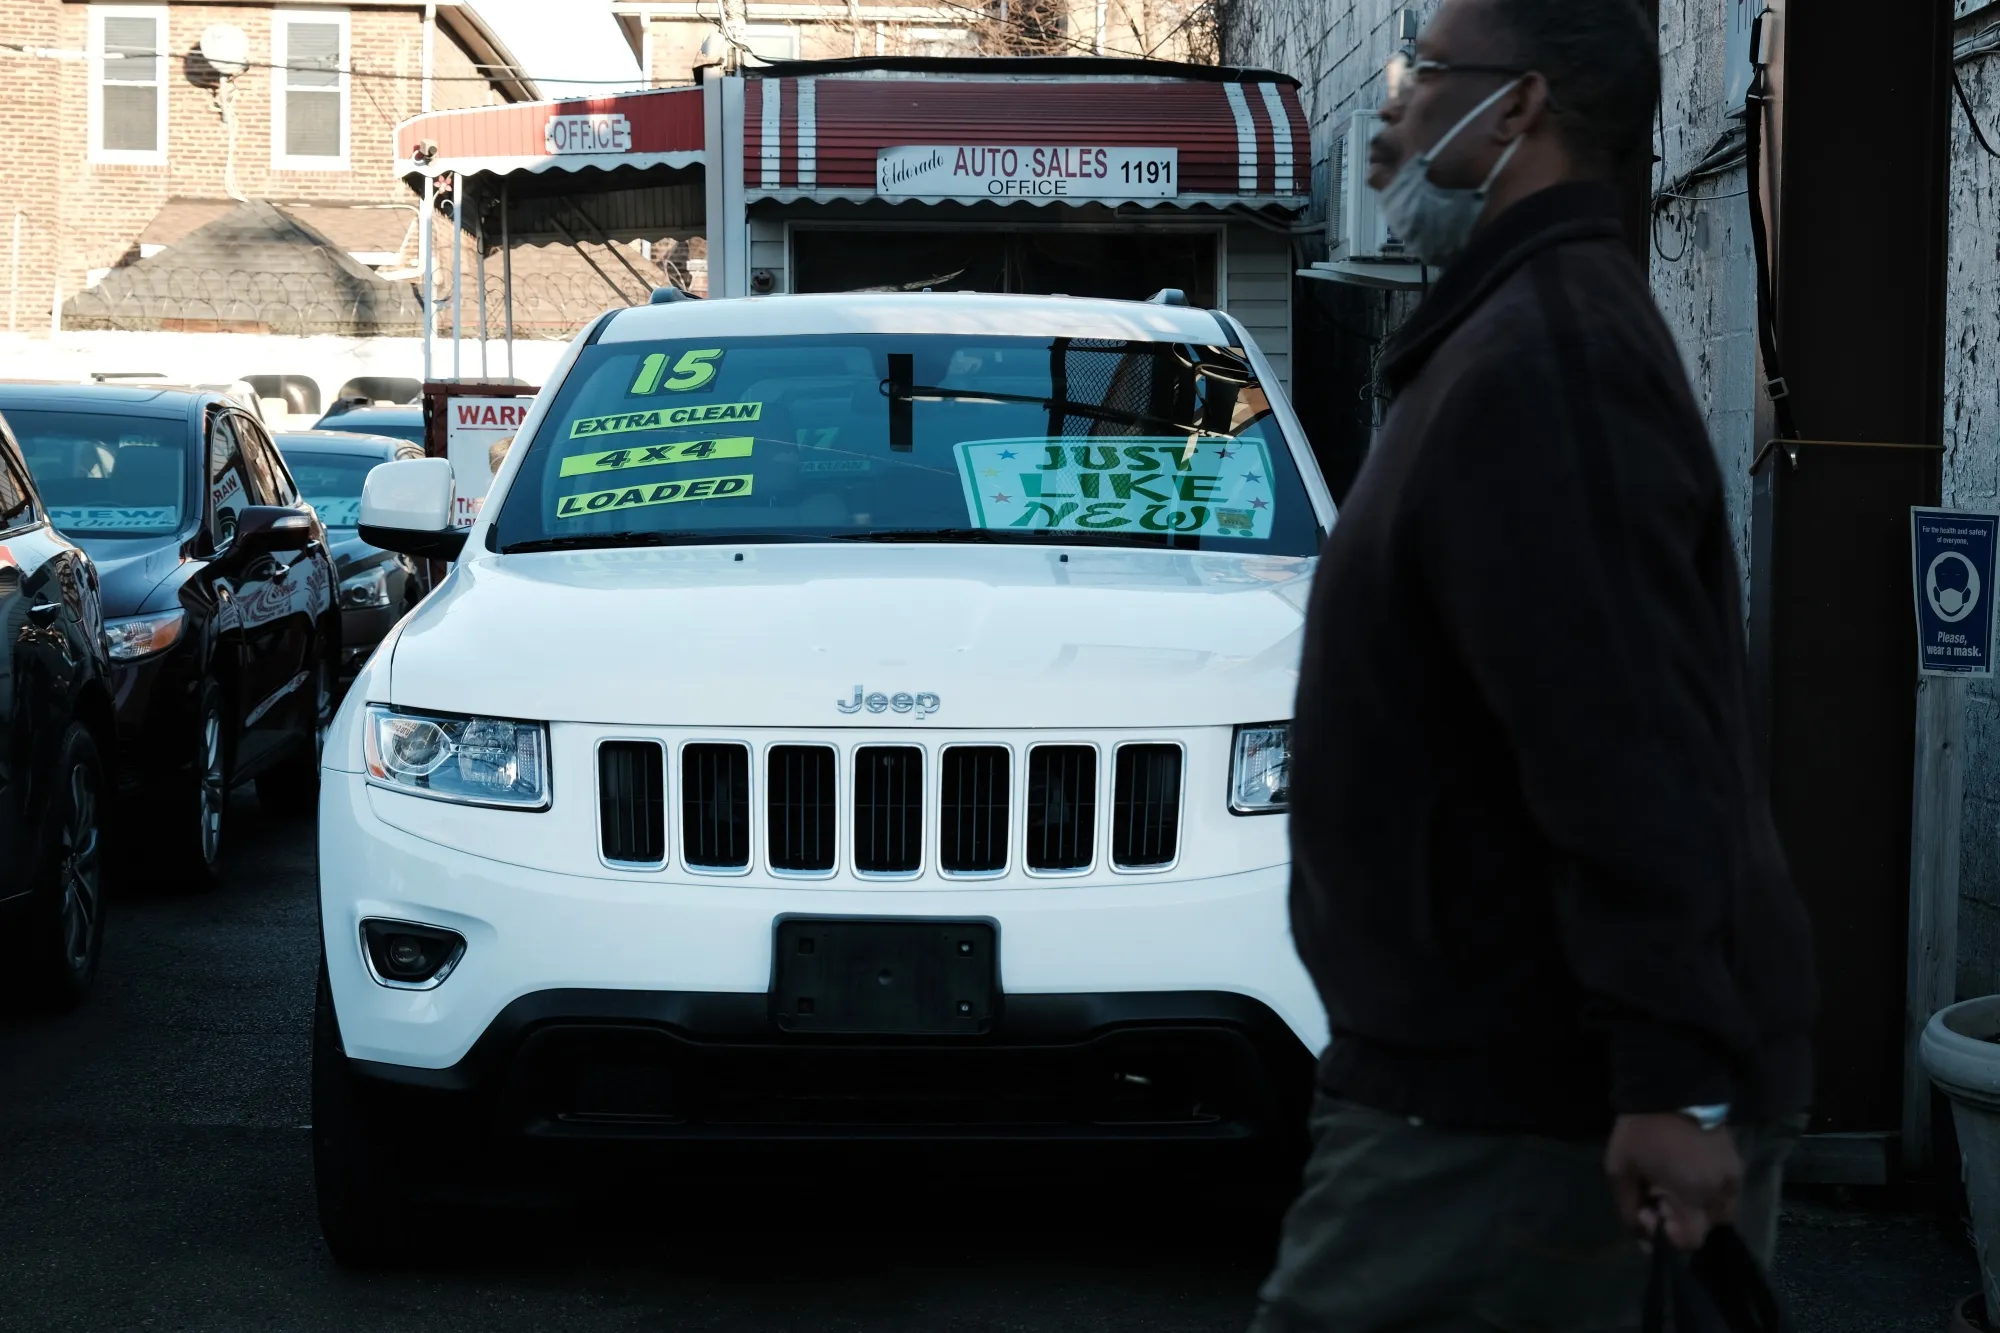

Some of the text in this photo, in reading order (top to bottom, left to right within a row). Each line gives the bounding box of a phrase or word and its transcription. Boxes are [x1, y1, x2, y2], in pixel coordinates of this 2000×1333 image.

[553, 119, 624, 150] OFFICE
[881, 149, 944, 188] Eldorado
[953, 147, 1108, 179] AUTO SALES
[1120, 160, 1171, 184] 1191
[987, 180, 1067, 195] OFFICE
[631, 348, 724, 395] 15
[574, 404, 759, 435] EXTRA CLEAN
[1035, 446, 1198, 471] JUST
[559, 478, 749, 515] LOADED
[1019, 473, 1229, 503] LIKE
[50, 510, 166, 519] NEW
[1008, 501, 1211, 532] NEW
[1922, 525, 1931, 533] For
[1931, 526, 1940, 534] the
[1940, 526, 1956, 534] health
[1968, 528, 1987, 537] safety
[1926, 645, 1982, 657] wear a mask.
[1937, 631, 1967, 646] Please,
[835, 685, 941, 720] Jeep
